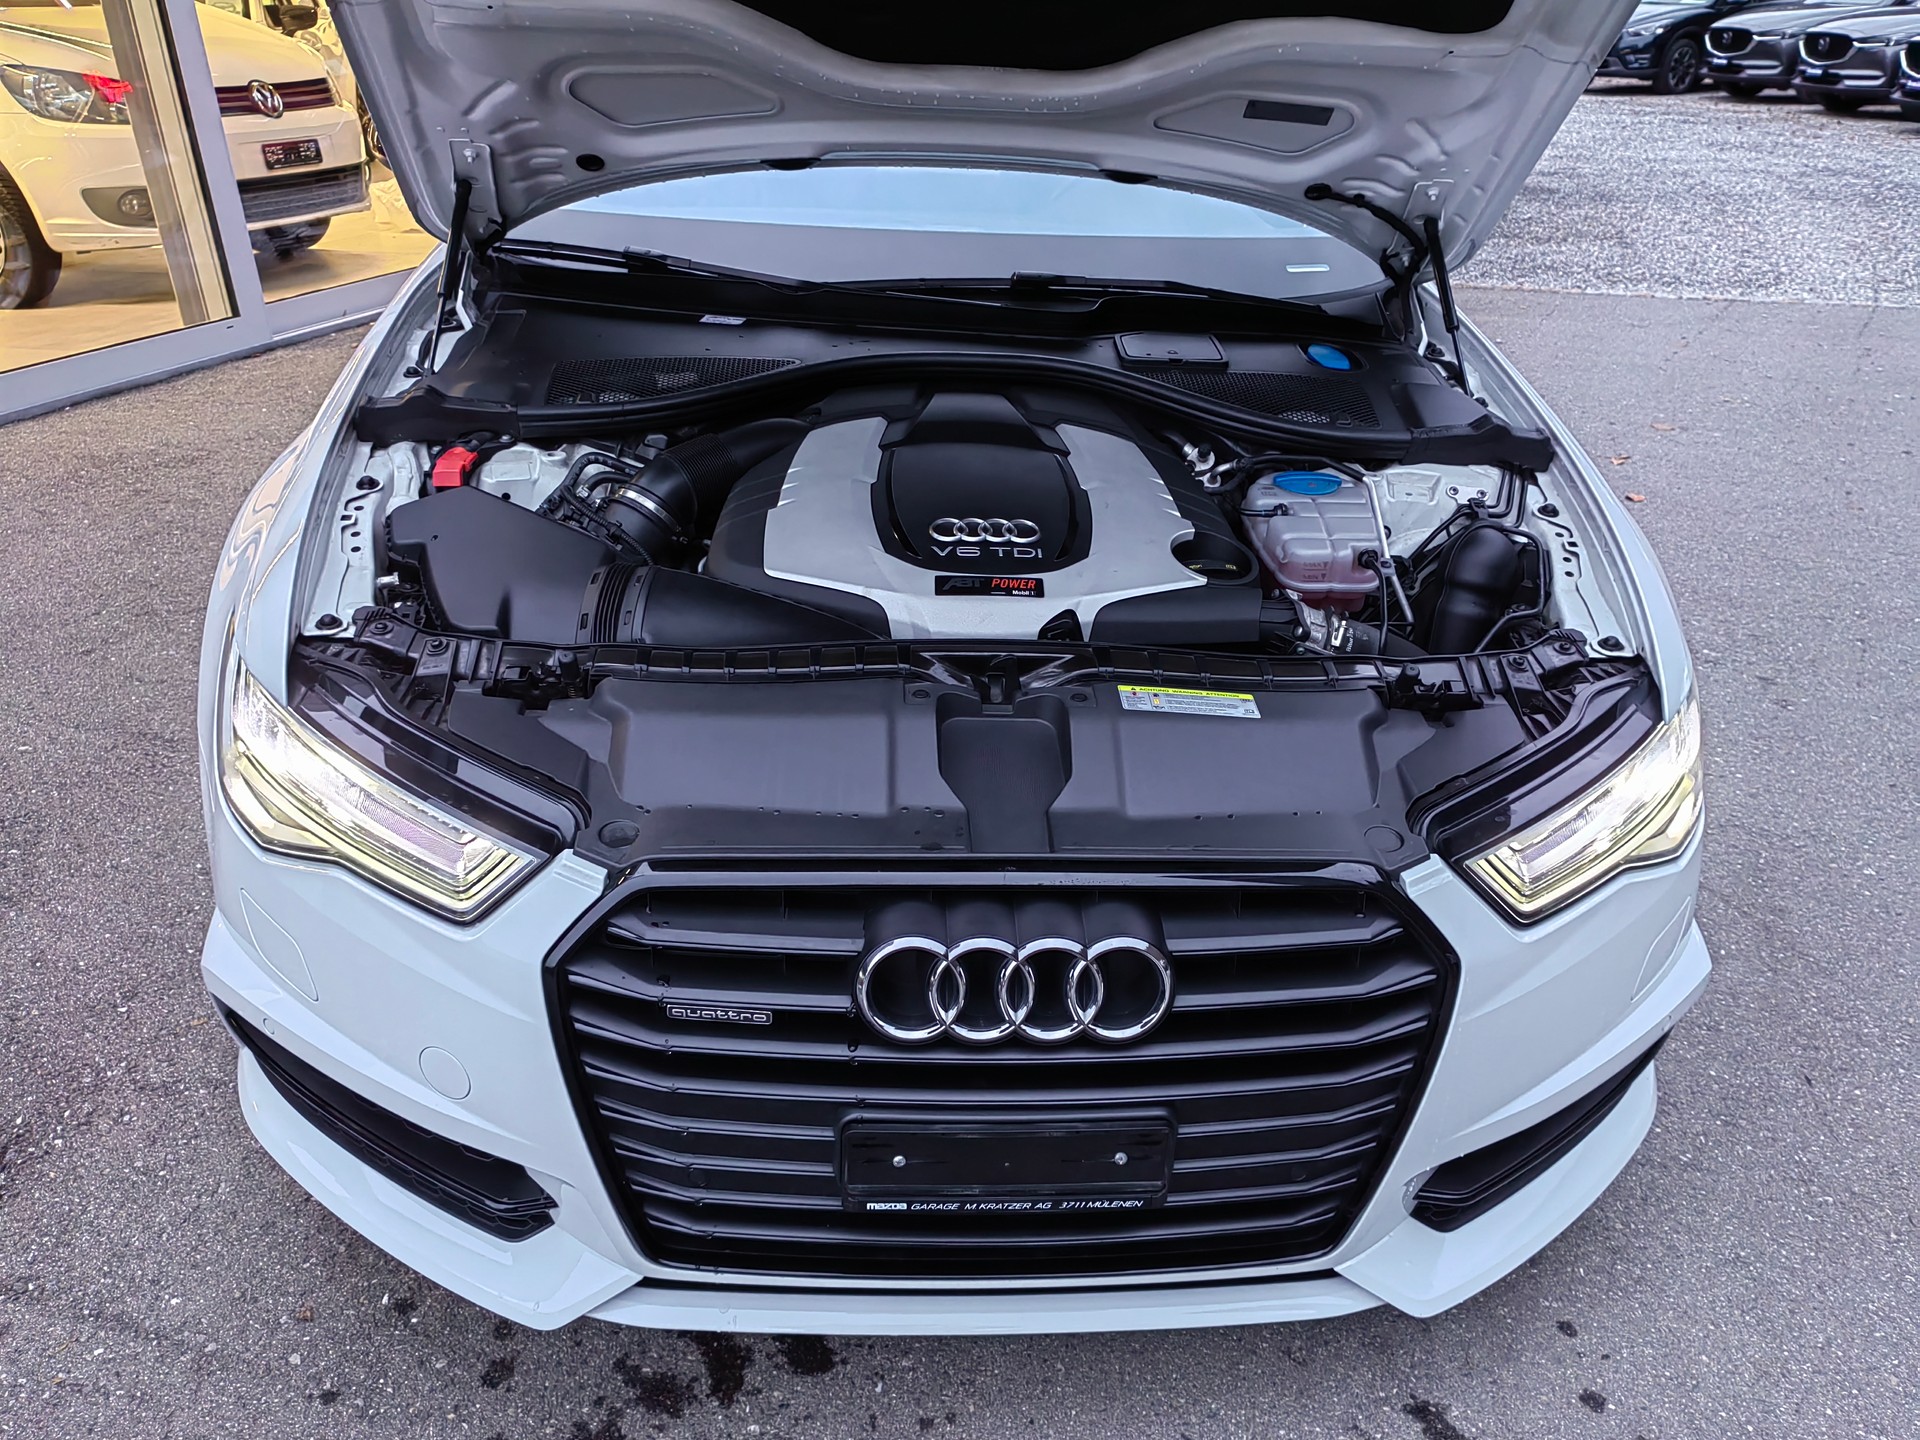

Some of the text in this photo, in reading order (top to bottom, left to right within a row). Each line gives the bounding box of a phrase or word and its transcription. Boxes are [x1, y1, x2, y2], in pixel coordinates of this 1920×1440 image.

[930, 545, 1043, 558] V6 TDI
[942, 577, 1037, 591] ABT POWER
[671, 1008, 767, 1022] quattro
[910, 1202, 960, 1210] GARAGE
[978, 1202, 1032, 1210] KRATZER
[1034, 1201, 1053, 1209] AG
[1058, 1201, 1086, 1209] 3711
[1086, 1199, 1144, 1208] MÜLENEN
